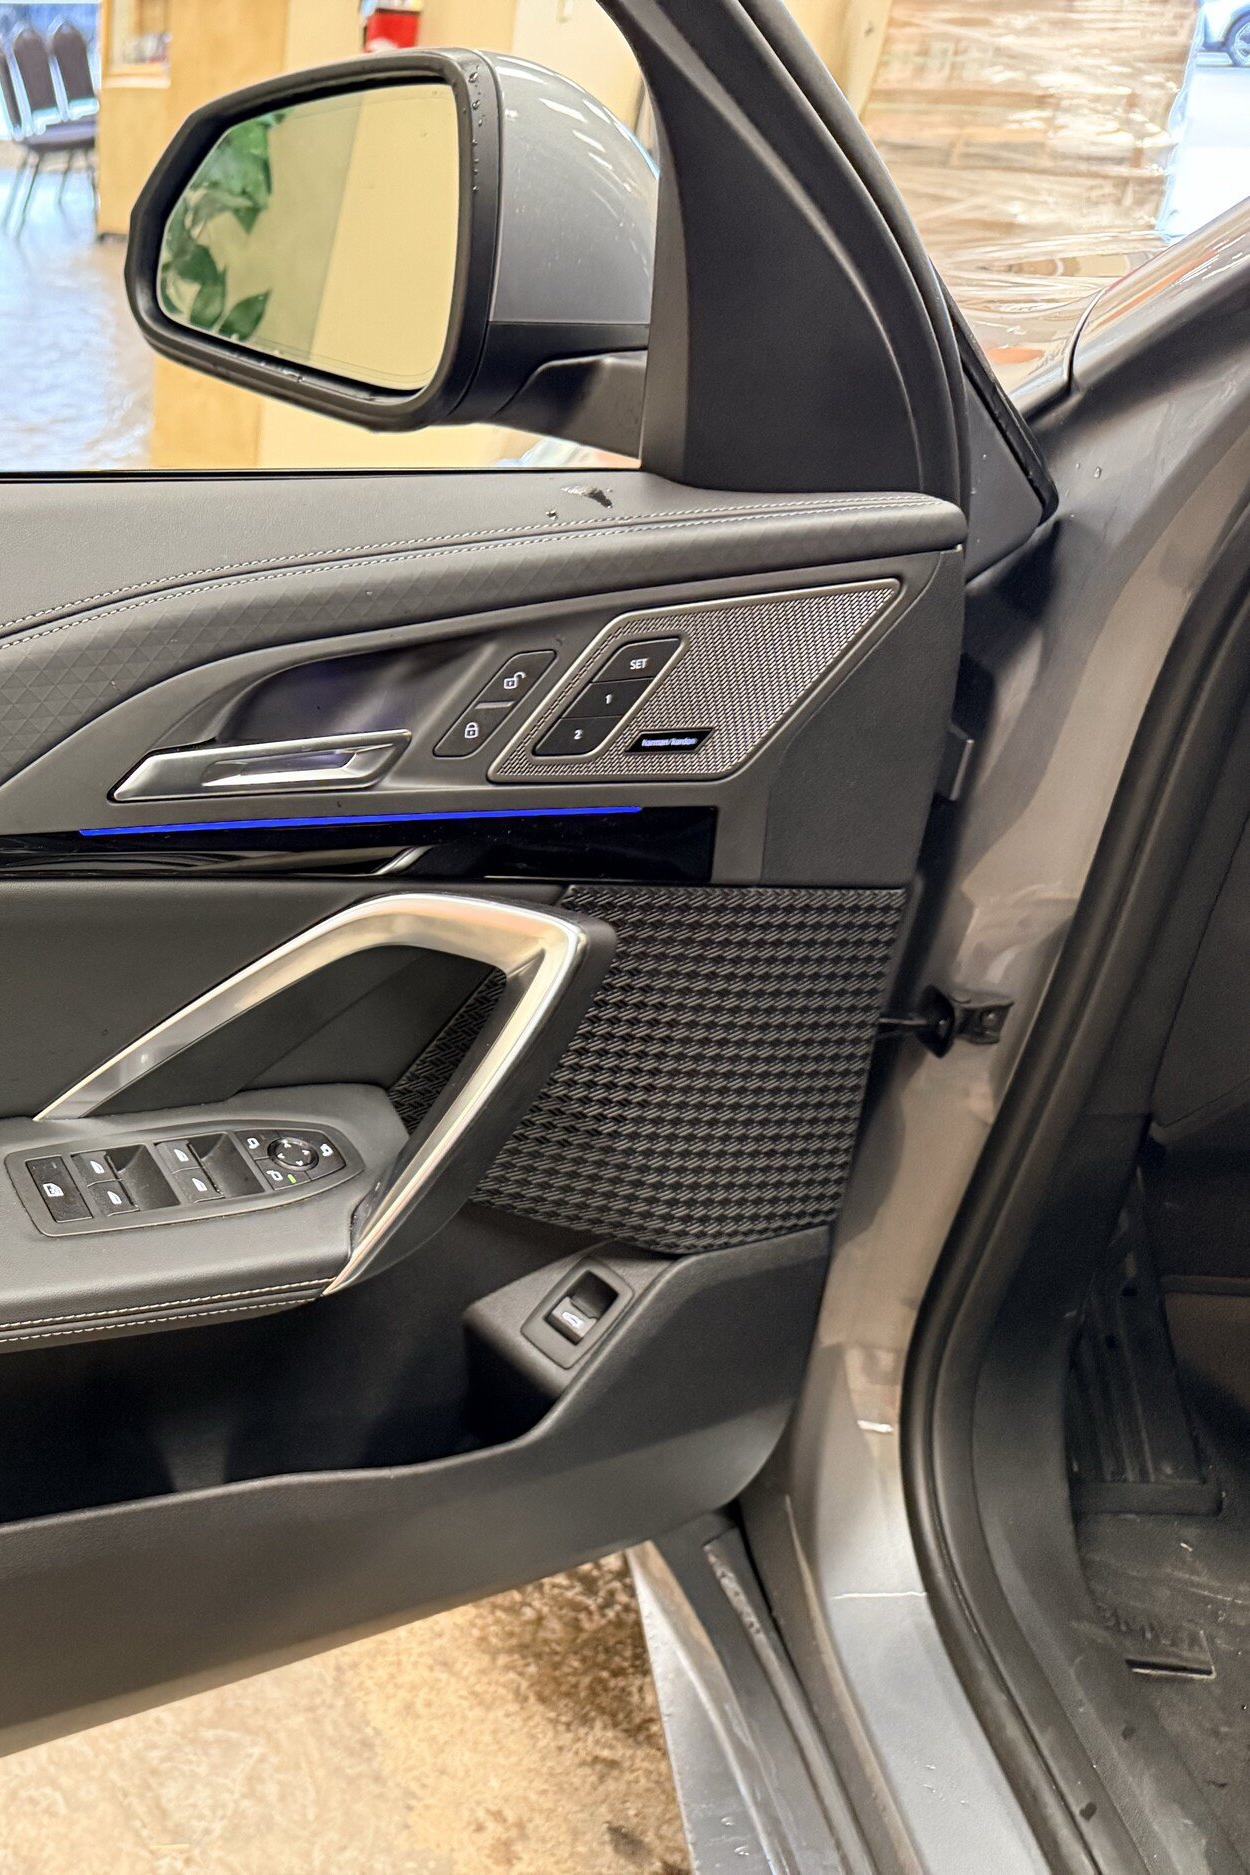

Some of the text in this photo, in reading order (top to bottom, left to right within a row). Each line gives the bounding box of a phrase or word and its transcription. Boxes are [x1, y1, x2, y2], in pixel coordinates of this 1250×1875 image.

[630, 658, 648, 670] SET
[605, 694, 613, 705] 1
[573, 729, 584, 740] 2
